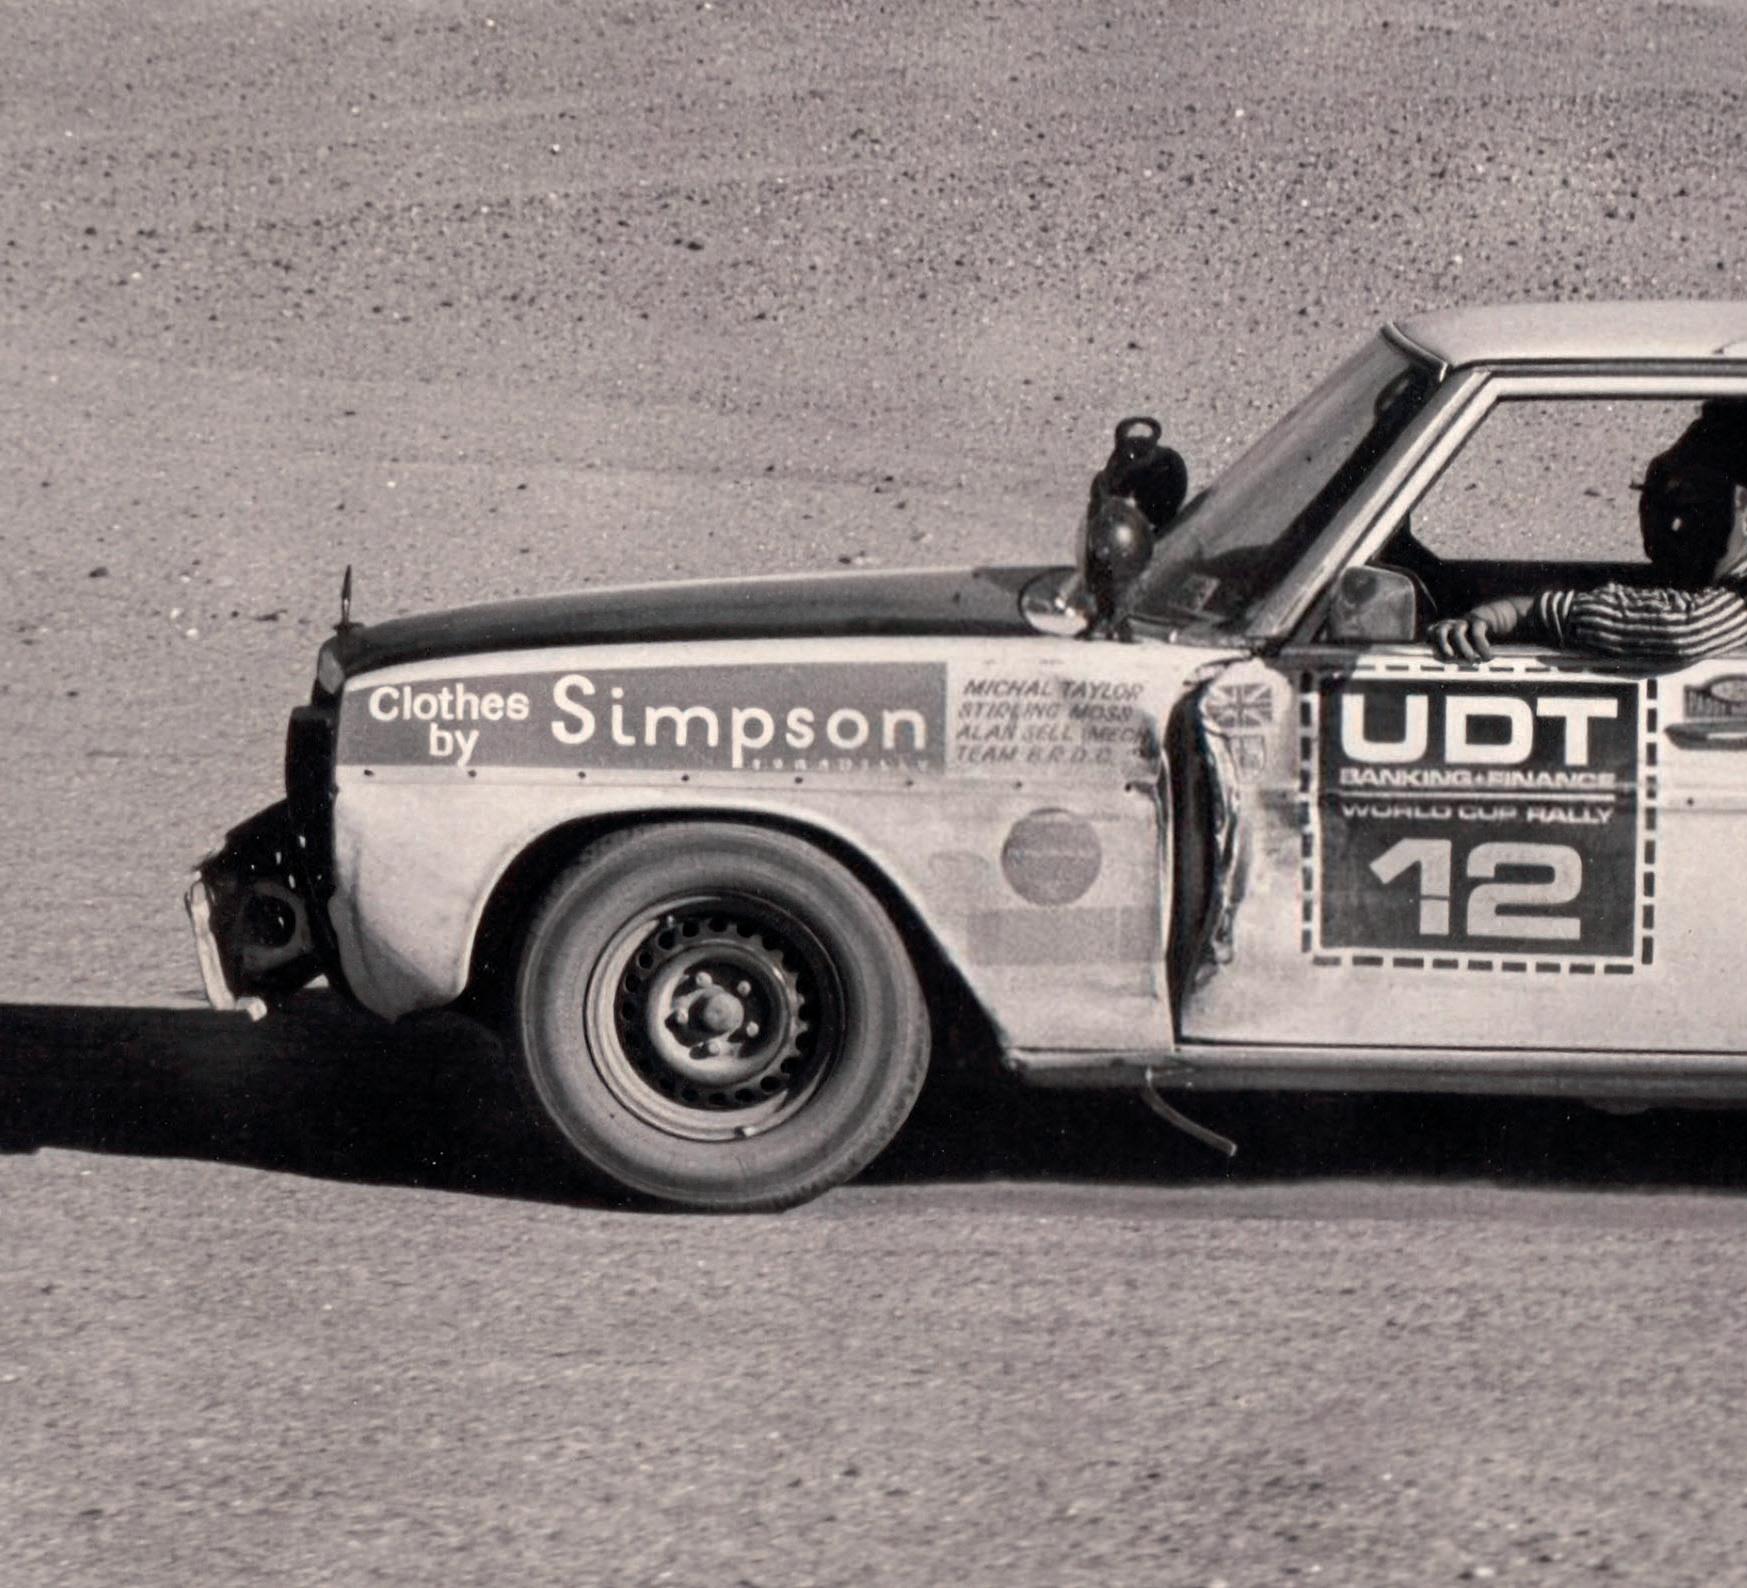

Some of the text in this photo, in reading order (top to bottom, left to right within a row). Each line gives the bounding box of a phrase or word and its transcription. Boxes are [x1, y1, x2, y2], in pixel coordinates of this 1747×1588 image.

[368, 683, 530, 722] Clothes
[1060, 680, 1145, 702] TAYLOR
[551, 674, 926, 769] Simpson
[958, 701, 1134, 723] STIRLING MOSS
[1341, 693, 1619, 767] UDT
[429, 723, 480, 767] by
[957, 743, 1019, 763] TEAM
[1341, 802, 1616, 825] WORLD CUP RALLY
[1368, 838, 1583, 942] 12
